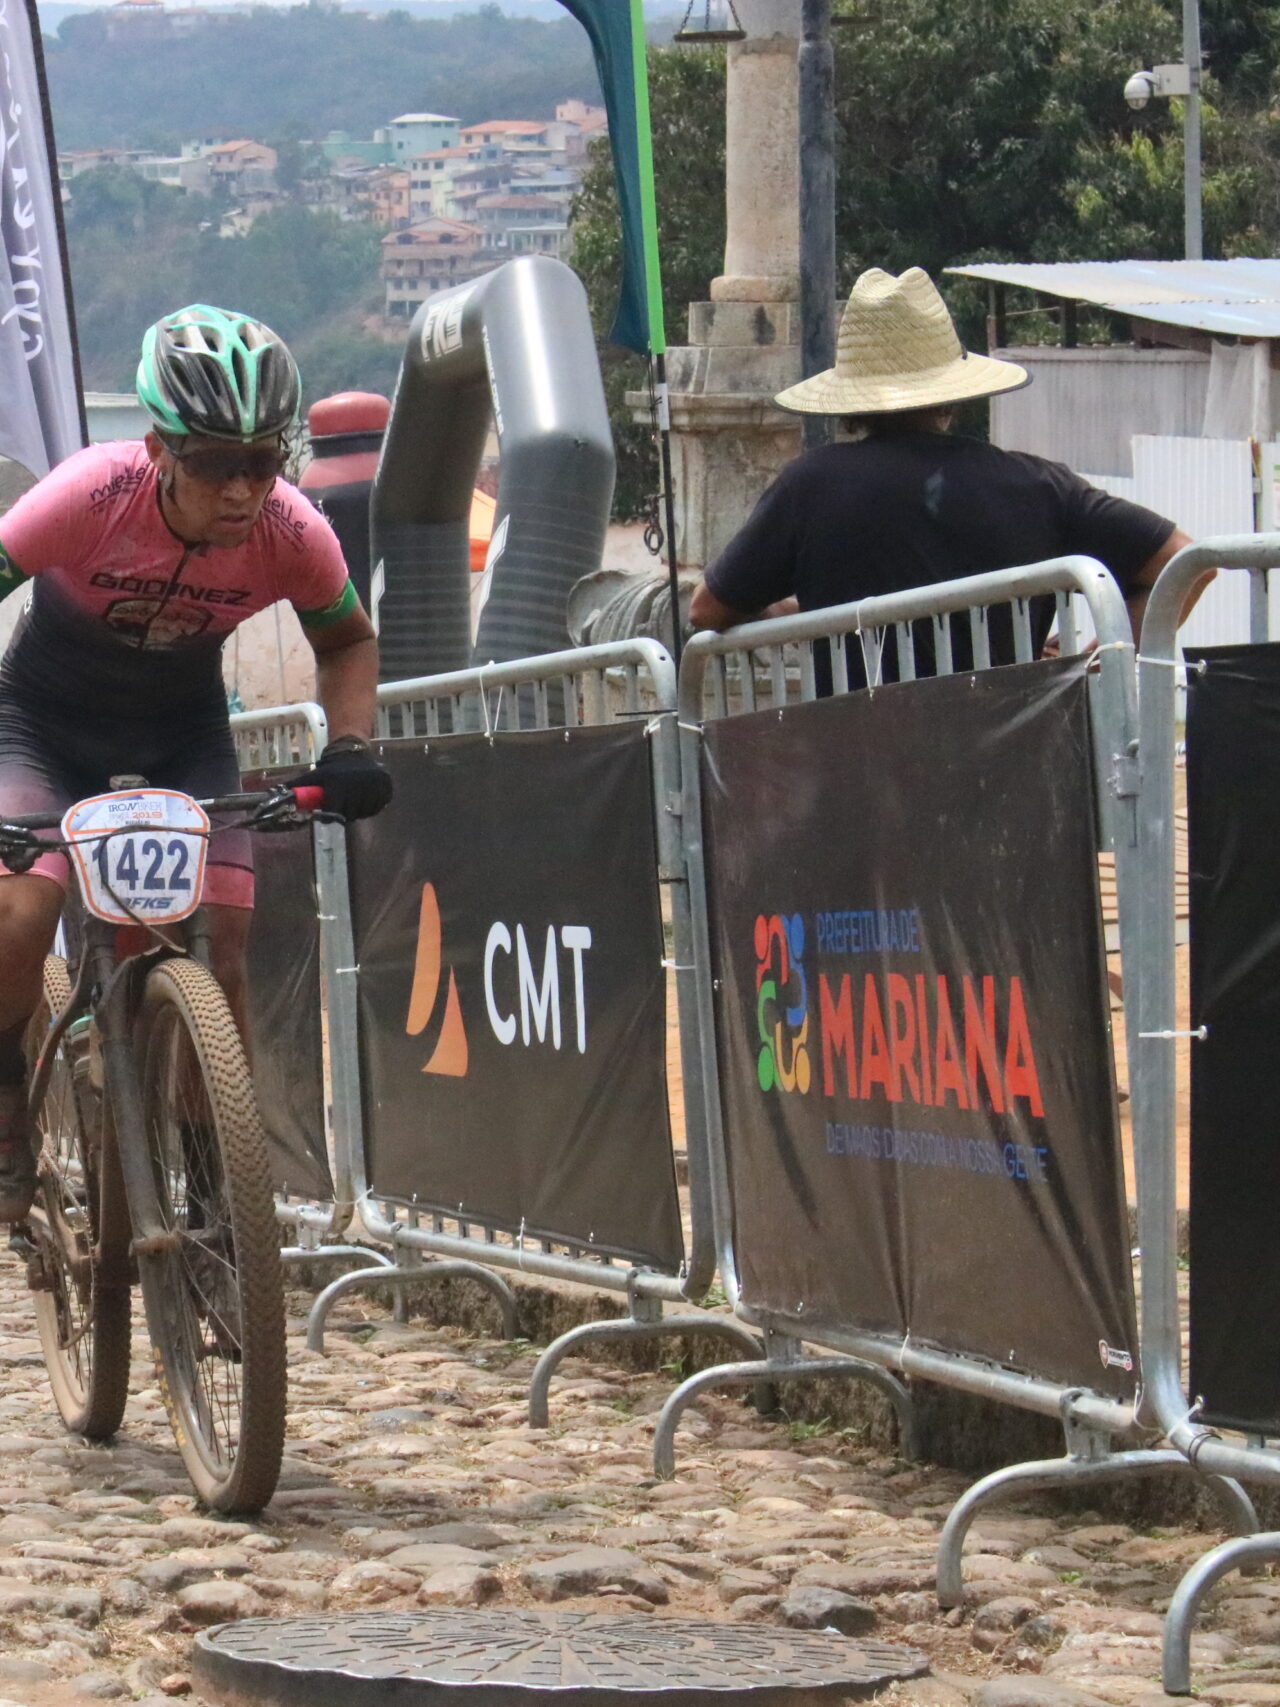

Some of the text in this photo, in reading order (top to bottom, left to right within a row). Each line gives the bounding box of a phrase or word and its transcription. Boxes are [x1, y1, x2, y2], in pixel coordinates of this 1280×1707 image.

[92, 838, 191, 891] 1422
[484, 920, 592, 1055] CMT
[820, 972, 1045, 1118] MARIANA
